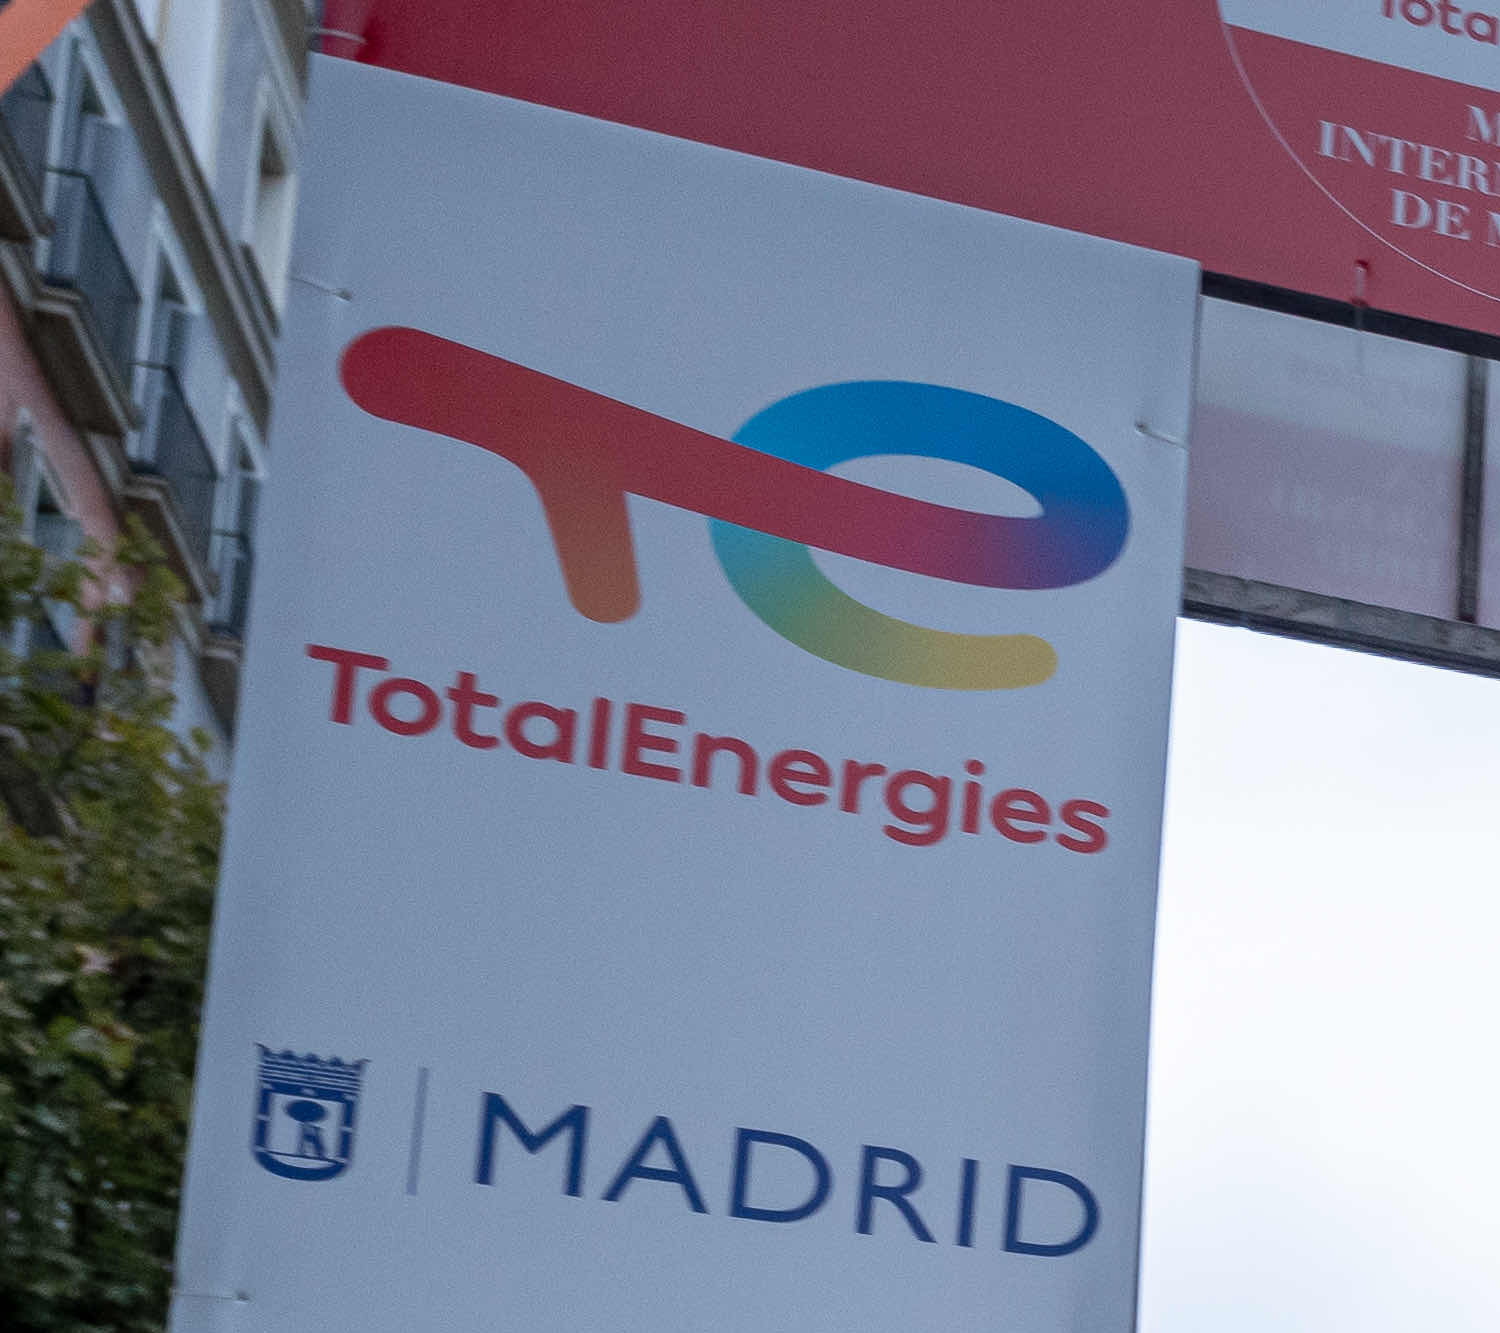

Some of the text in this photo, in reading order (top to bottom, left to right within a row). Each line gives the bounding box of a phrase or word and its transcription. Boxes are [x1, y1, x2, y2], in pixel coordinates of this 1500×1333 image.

[1390, 188, 1473, 241] DE
[307, 643, 1110, 855] TotalEnergies
[475, 1090, 1101, 1259] MADRID
